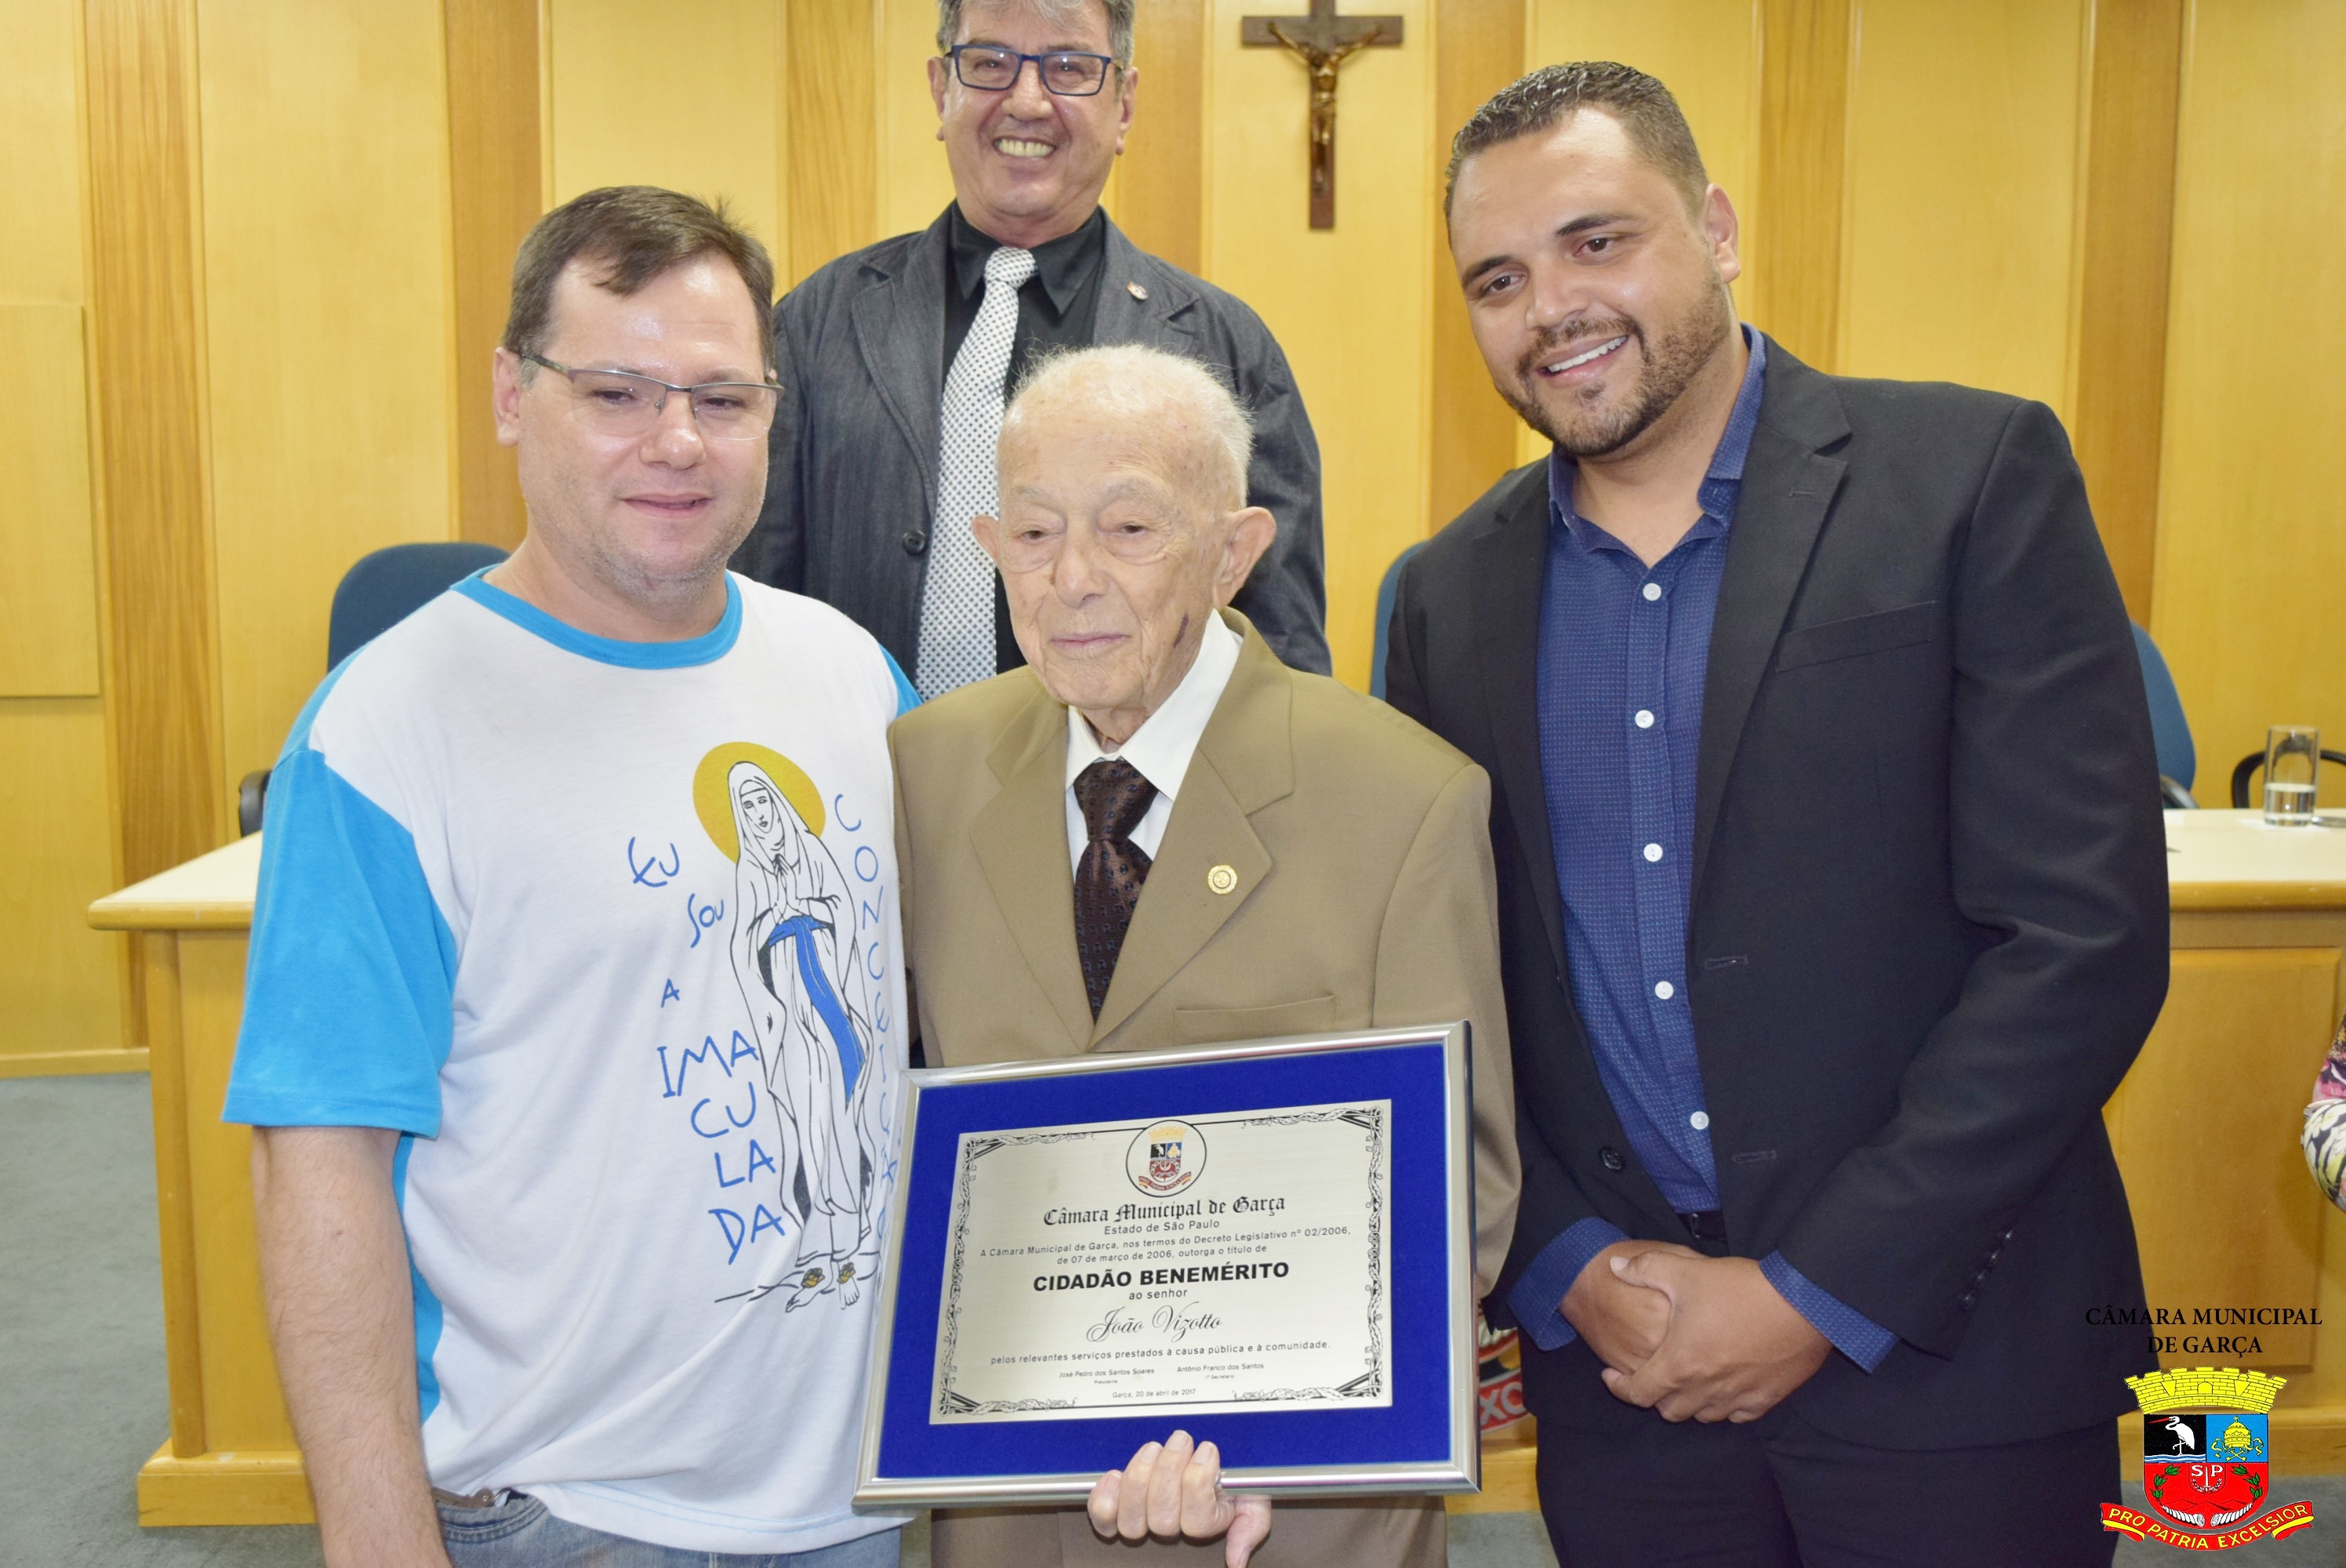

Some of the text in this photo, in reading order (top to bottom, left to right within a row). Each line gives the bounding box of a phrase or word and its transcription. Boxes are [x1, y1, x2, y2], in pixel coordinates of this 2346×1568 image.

[661, 978, 680, 1008] A
[657, 1030, 759, 1098] IMA
[691, 1081, 757, 1138] CU
[714, 1139, 776, 1188] LA
[1044, 1196, 1285, 1226] Câmara Municipal de Garça
[709, 1203, 786, 1265] DA
[990, 1247, 1024, 1257] Câmara
[1027, 1243, 1072, 1254] Municipal
[1074, 1243, 1086, 1251] de
[1088, 1242, 1119, 1251] Garça,
[1143, 1238, 1176, 1247] termos
[1178, 1236, 1191, 1245] do
[1194, 1234, 1232, 1244] Decreto
[1235, 1231, 1287, 1242] Legislativo
[1304, 1226, 1351, 1237] 02/2006,
[1104, 1219, 1220, 1235] Estado de São Paulo
[1071, 1255, 1083, 1264] 07
[1085, 1254, 1097, 1263] de
[1099, 1254, 1129, 1262] março
[1131, 1251, 1143, 1260] de
[1147, 1250, 1175, 1259] 2006,
[1178, 1248, 1215, 1258] outorga
[1227, 1245, 1252, 1254] título
[1255, 1244, 1267, 1253] de
[1033, 1261, 1290, 1291] CIDADÃO BENEMÉRITO
[1128, 1288, 1188, 1301] ao senhor
[1086, 1301, 1222, 1343] João Vizotto
[990, 1356, 1016, 1365] pelos
[1019, 1353, 1068, 1363] relevantes
[1071, 1351, 1112, 1361] serviços
[1115, 1348, 1164, 1359] prestados
[1167, 1346, 1172, 1356] à
[1175, 1347, 1205, 1356] causa
[1208, 1344, 1244, 1355] pública
[1256, 1342, 1262, 1352] à
[1266, 1340, 1331, 1351] comunidade.
